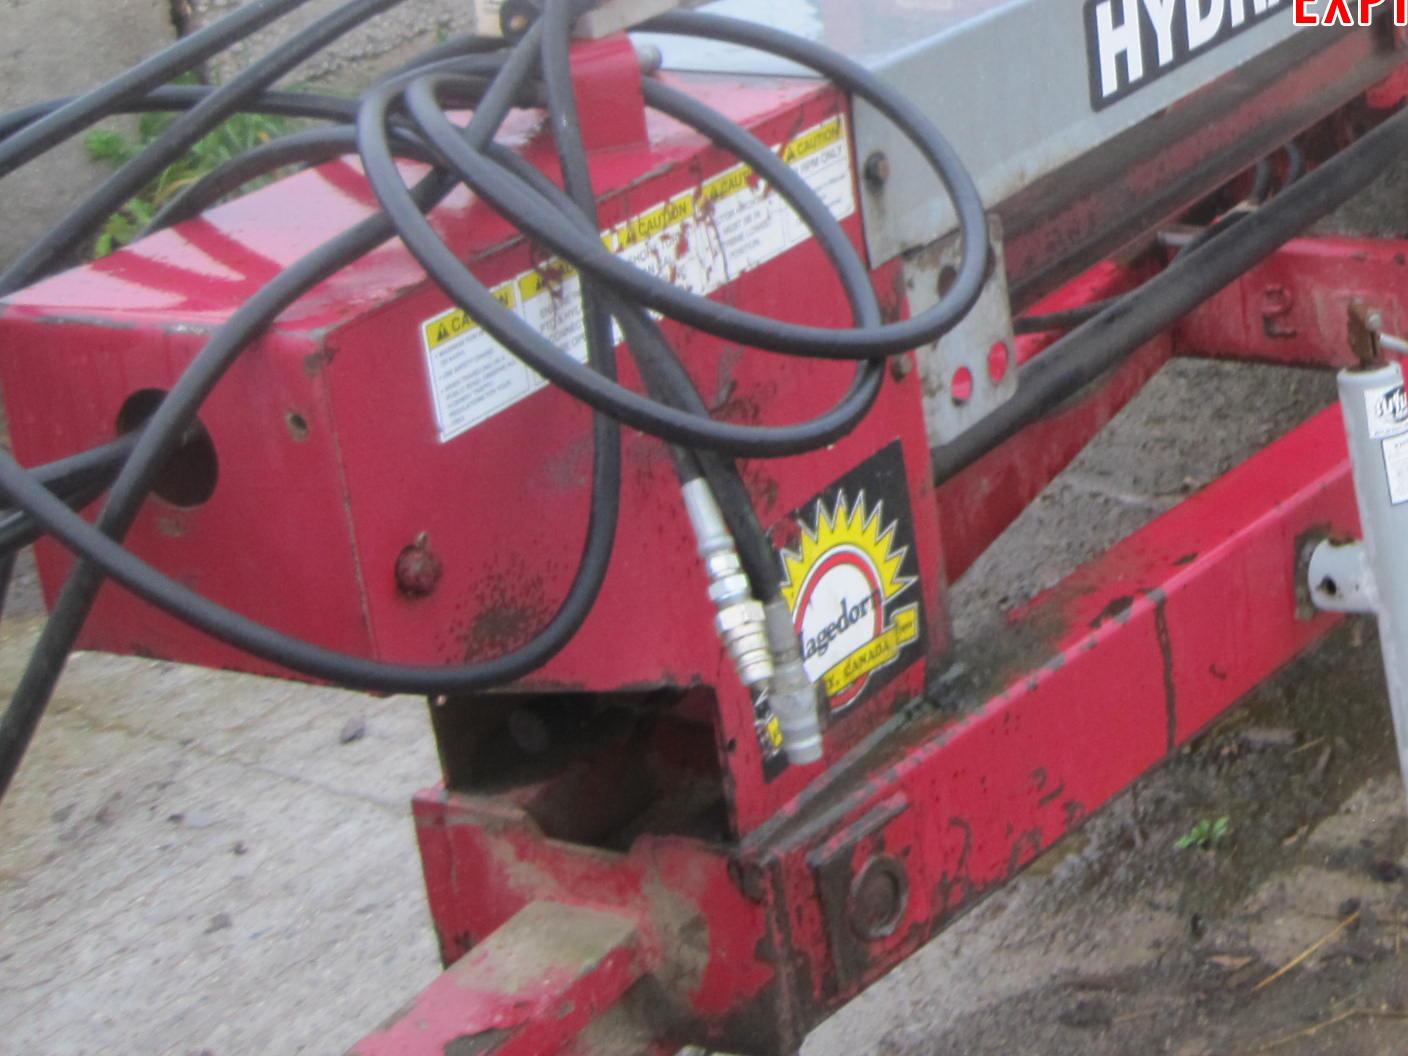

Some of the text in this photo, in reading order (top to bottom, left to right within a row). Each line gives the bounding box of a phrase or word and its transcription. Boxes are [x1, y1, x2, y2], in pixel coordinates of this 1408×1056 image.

[796, 123, 841, 155] CAUTION
[637, 202, 688, 237] CAUTION
[844, 639, 891, 677] CANADA
